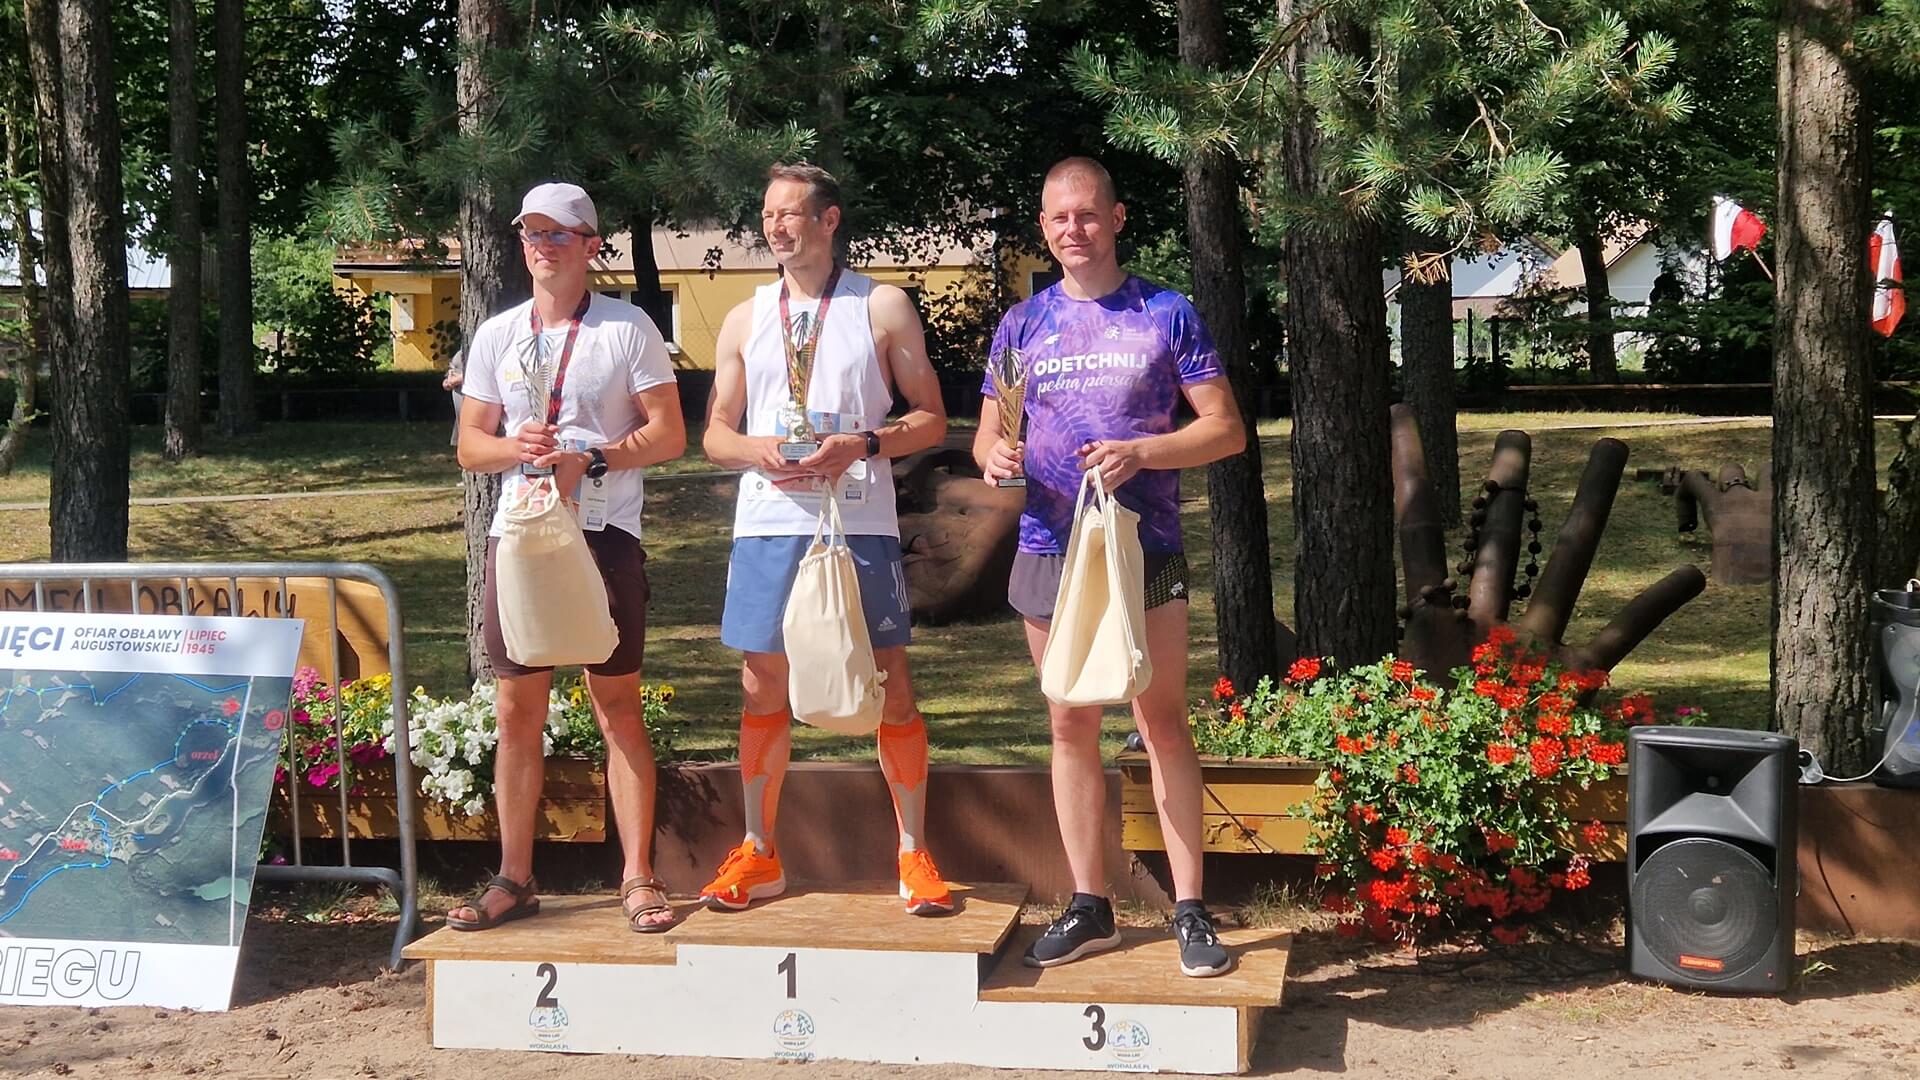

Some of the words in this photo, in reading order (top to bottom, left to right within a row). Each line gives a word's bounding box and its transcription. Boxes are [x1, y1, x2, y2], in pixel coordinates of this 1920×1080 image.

[1034, 352, 1147, 376] ODETCHNIJ
[74, 627, 117, 639] OFIAR
[119, 628, 183, 640] OBŁAWY
[188, 630, 227, 642] LIPIEC
[70, 640, 180, 654] AUGUSTOWSKIEJ
[186, 642, 215, 655] 1945
[0, 946, 141, 1000] IEGU
[535, 962, 559, 1008] 2
[777, 952, 797, 999] 1
[1082, 1004, 1107, 1051] 3
